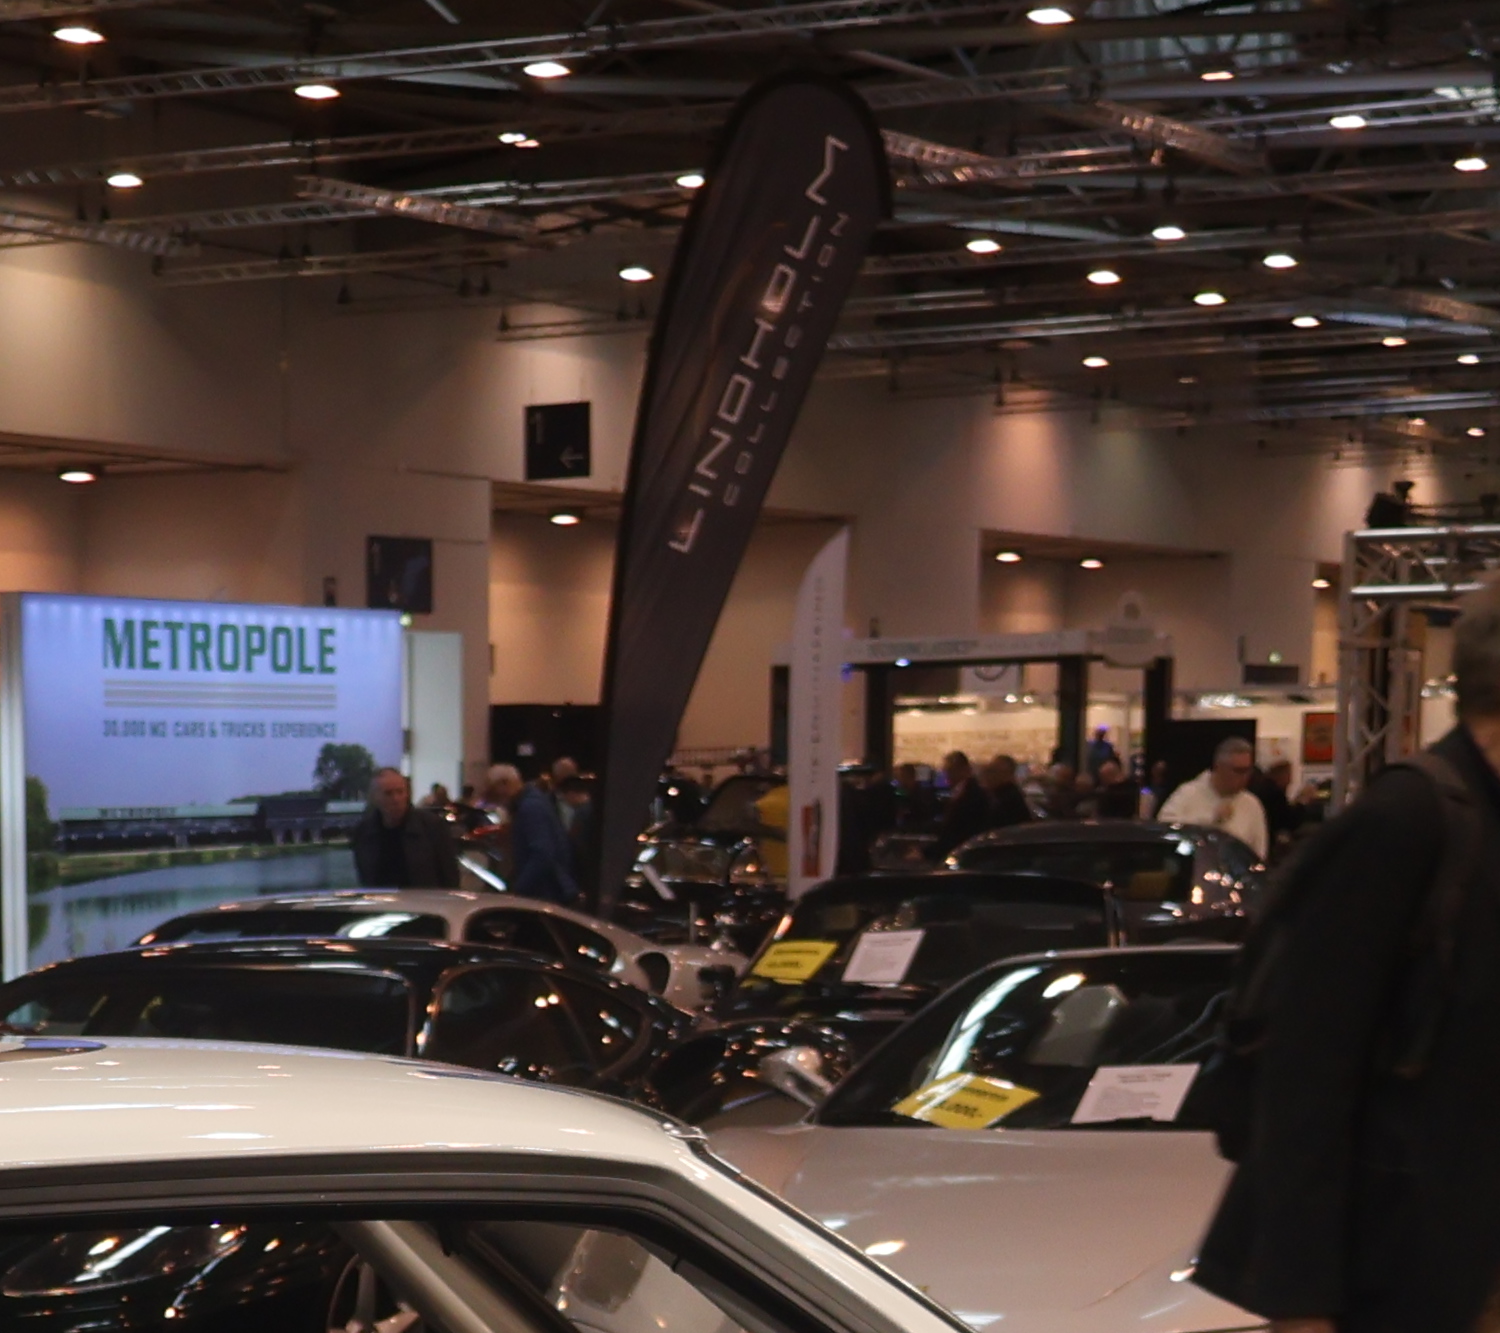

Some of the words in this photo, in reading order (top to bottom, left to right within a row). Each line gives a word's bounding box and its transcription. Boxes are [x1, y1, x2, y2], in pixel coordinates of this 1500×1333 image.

[668, 133, 850, 555] LINDHOLM
[102, 617, 338, 676] METROPOLE
[173, 720, 206, 739] CARS
[221, 721, 267, 740] TRUCKS
[271, 721, 338, 741] EXPERIENCE
